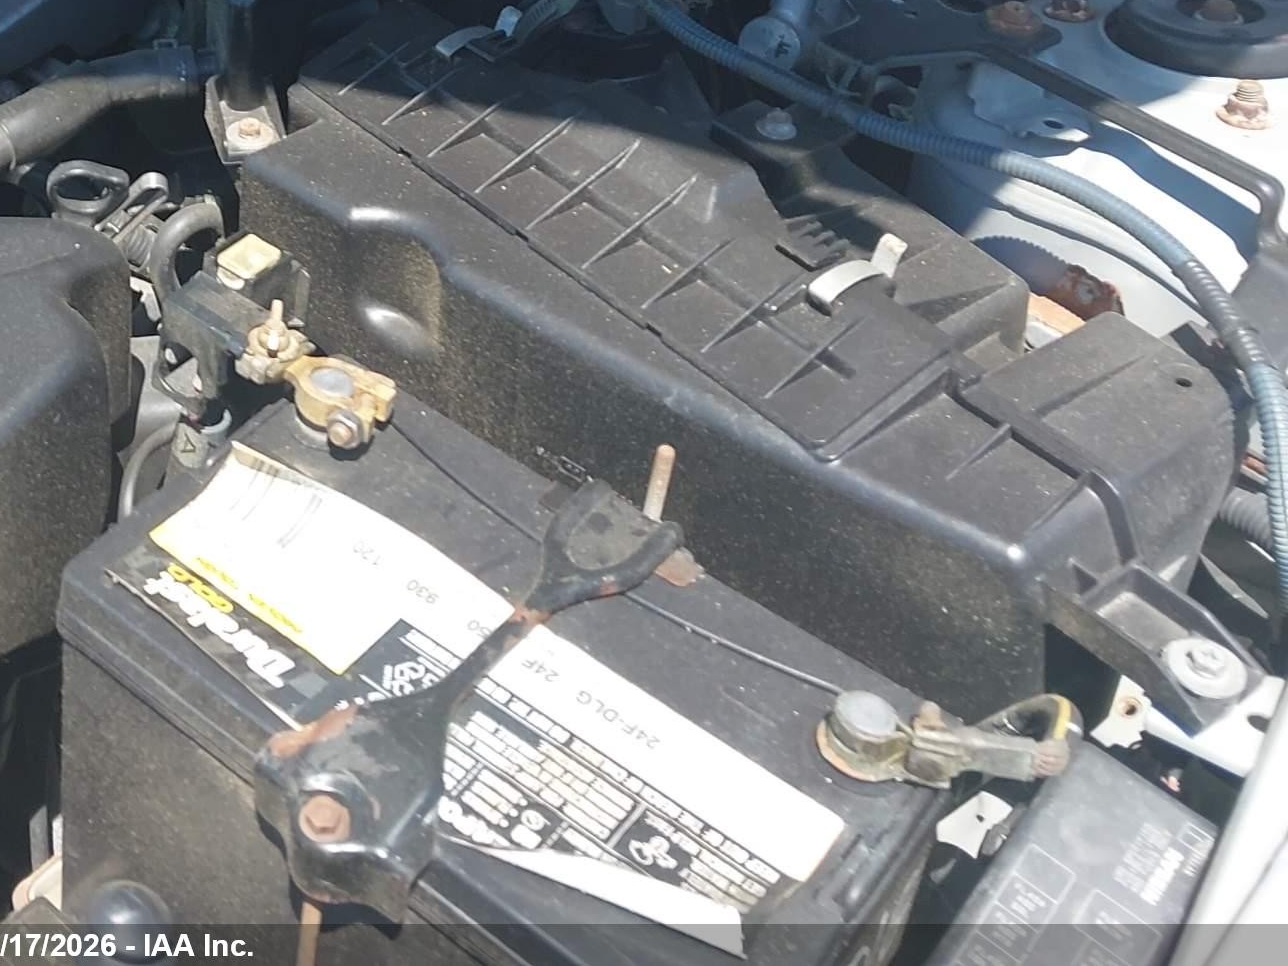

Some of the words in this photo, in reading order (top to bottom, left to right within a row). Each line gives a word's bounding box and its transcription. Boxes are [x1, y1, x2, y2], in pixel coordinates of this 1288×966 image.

[167, 563, 234, 613] GOLD
[406, 579, 440, 605] 930
[143, 570, 296, 688] Duralast
[521, 657, 560, 683] 24F
[575, 689, 661, 750] 24F-DLG
